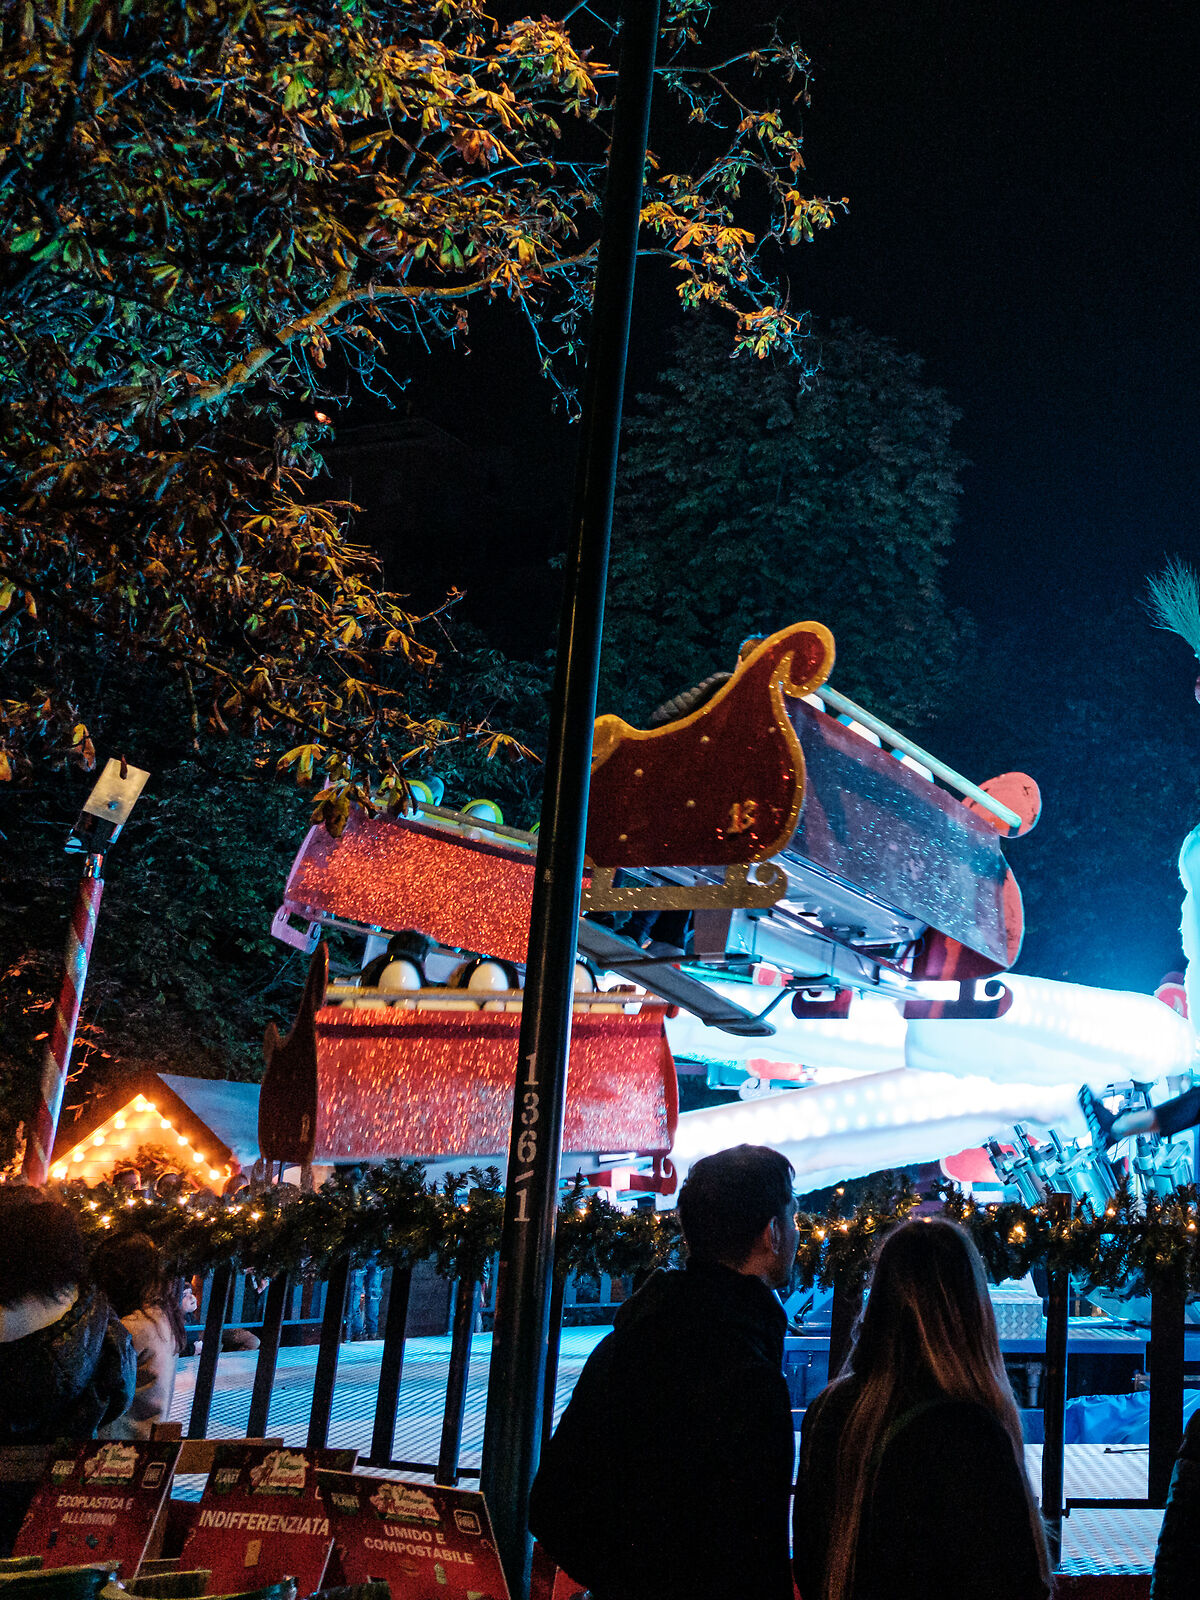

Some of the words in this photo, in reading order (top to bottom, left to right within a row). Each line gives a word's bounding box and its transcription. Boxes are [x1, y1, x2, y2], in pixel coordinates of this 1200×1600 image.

[56, 1495, 124, 1510] ECOPLASTICA
[125, 1498, 134, 1510] E
[198, 1509, 330, 1536] INDIFFERENZIATA
[383, 1525, 432, 1543] UMIDO
[436, 1533, 446, 1545] E
[364, 1537, 475, 1565] COMPOSTABILE
